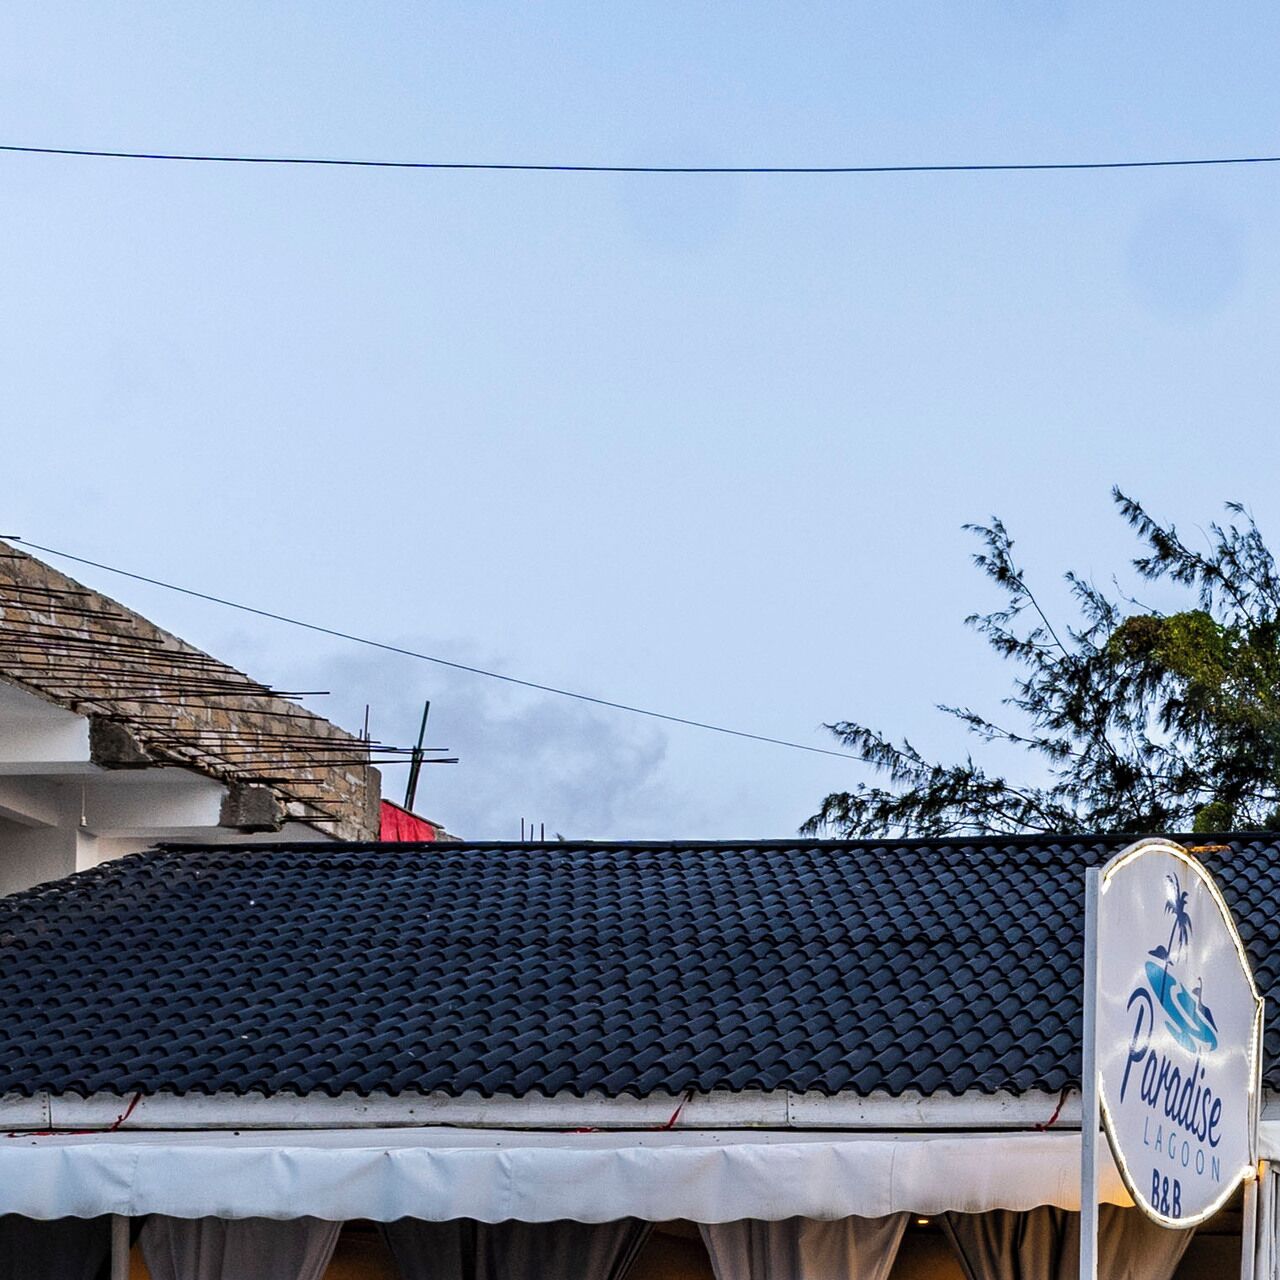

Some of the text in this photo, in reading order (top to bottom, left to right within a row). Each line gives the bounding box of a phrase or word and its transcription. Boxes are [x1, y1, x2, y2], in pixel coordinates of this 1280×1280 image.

[1119, 986, 1223, 1148] Paradise
[1142, 1116, 1221, 1184] LAGOON
[1151, 1168, 1182, 1219] B&B
